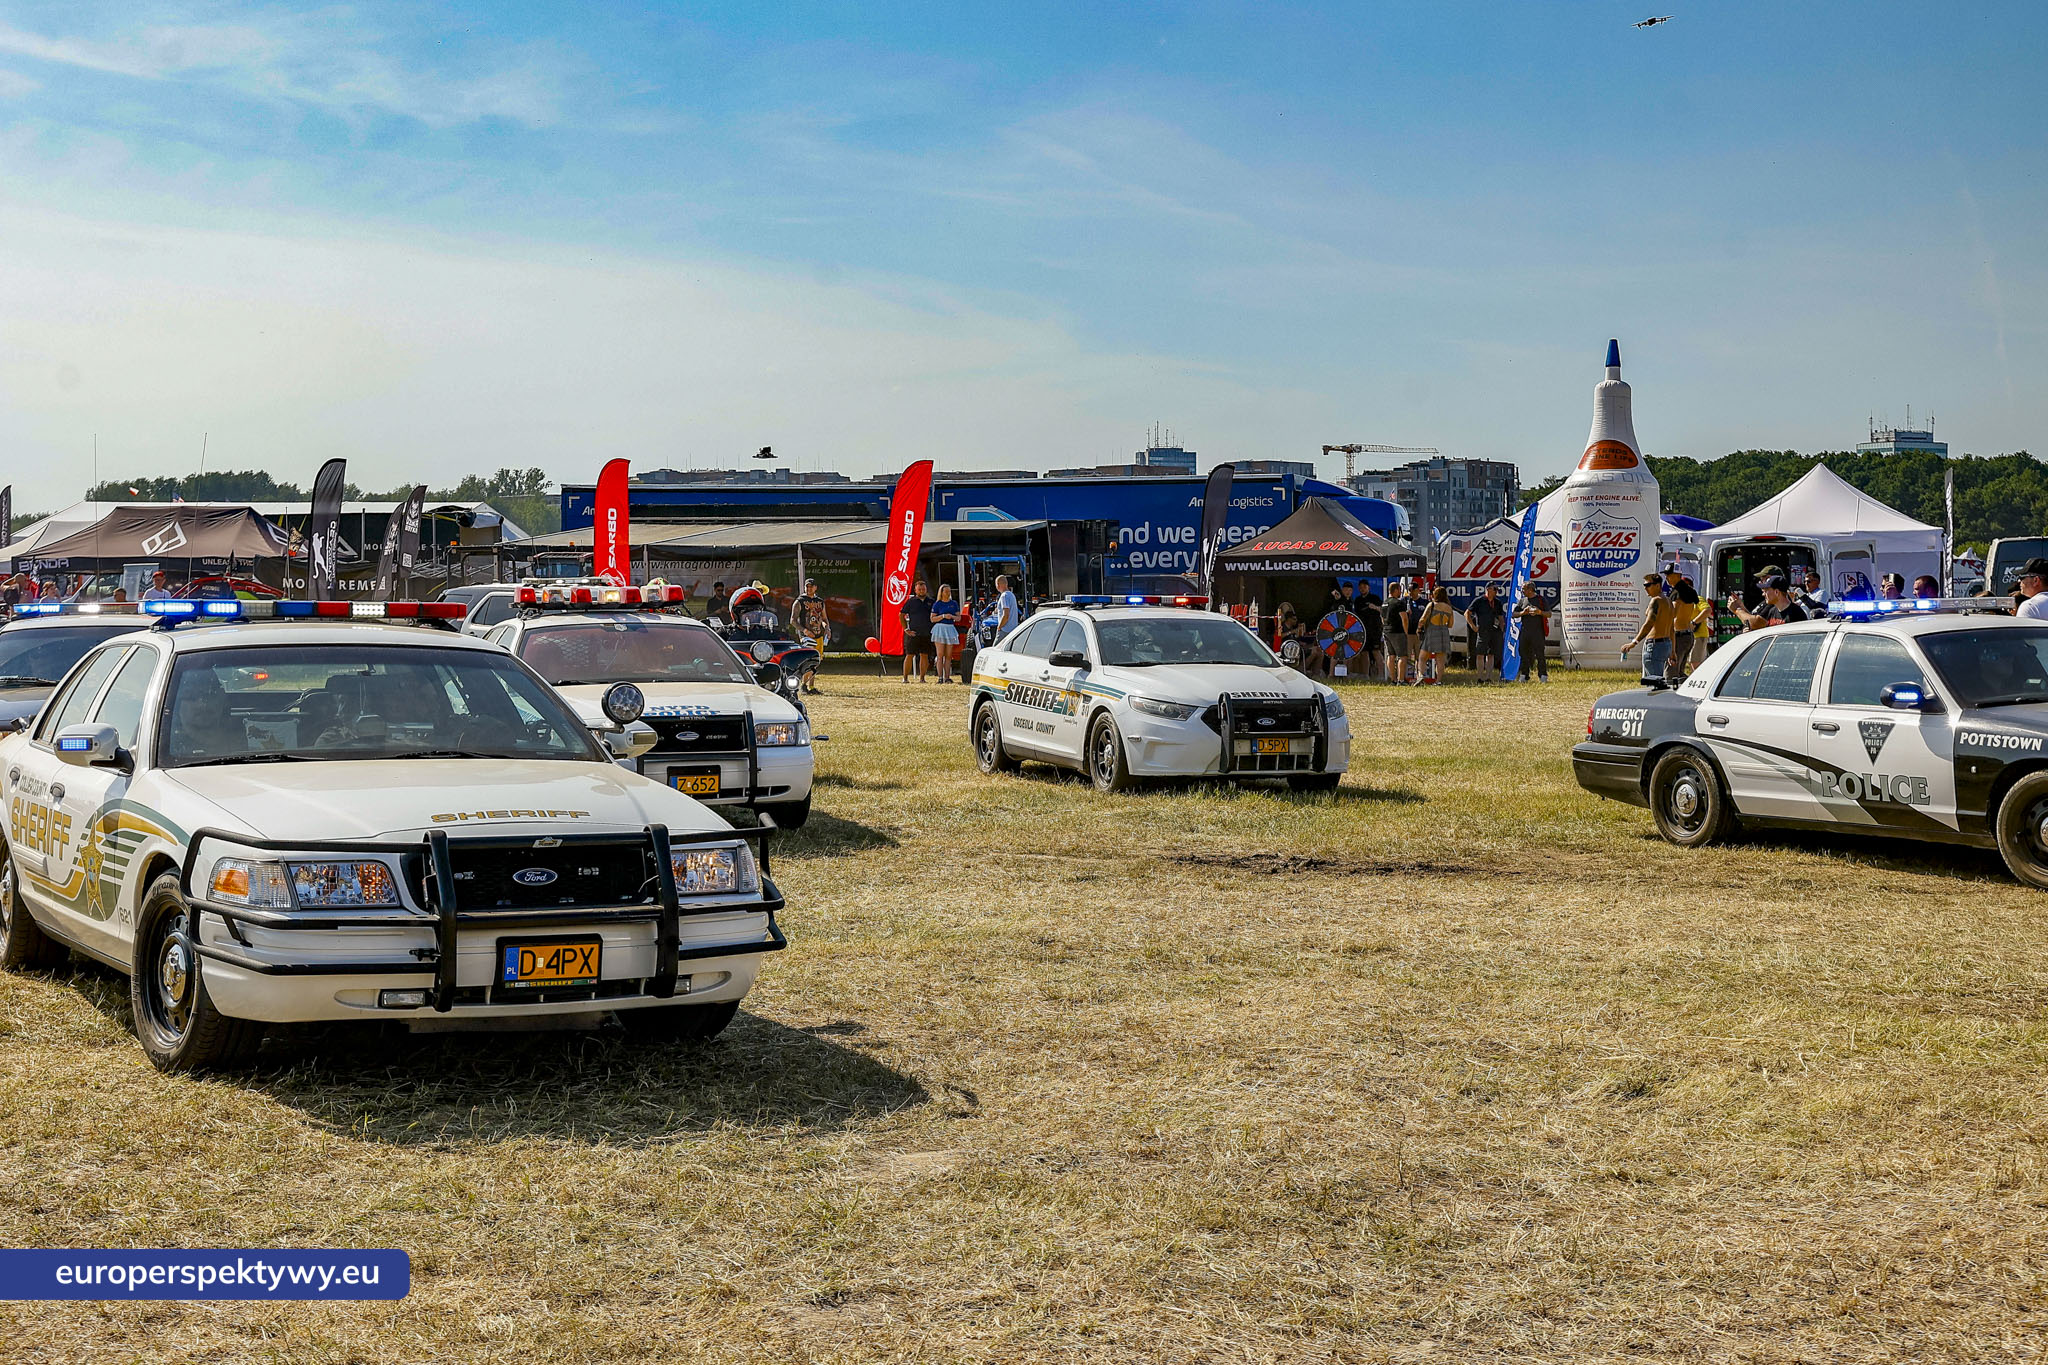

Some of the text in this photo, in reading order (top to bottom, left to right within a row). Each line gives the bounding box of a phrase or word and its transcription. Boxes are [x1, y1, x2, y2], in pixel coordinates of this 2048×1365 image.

[1228, 496, 1273, 509] Logistics
[607, 507, 617, 569] SARBO
[897, 509, 914, 573] SARBO
[1157, 525, 1195, 544] we
[1571, 531, 1637, 548] LUCAS
[1251, 541, 1349, 551] LUCAS OIL
[1569, 550, 1636, 561] HEAVY DUTY
[1224, 559, 1373, 573] www.LucasOil.co.uk
[1451, 555, 1556, 578] LUCS
[1574, 560, 1628, 569] Oil Stabilizer
[1446, 586, 1471, 597] OIL
[1687, 680, 1708, 689] 94-22
[1004, 682, 1061, 711] SHERIFF
[1230, 691, 1289, 699] SHERIFF
[1595, 708, 1648, 720] EMERGENCY
[1013, 716, 1034, 731] OSCEOLA
[1035, 721, 1057, 735] COUNTY
[1621, 720, 1644, 737] 911
[1258, 739, 1287, 751] D 5PX
[1864, 738, 1884, 746] POLICE
[1959, 731, 2043, 751] POTTSTOWN
[678, 777, 716, 792] Z 652
[1820, 770, 1931, 806] POLICE
[430, 809, 591, 823] SHERIFF
[11, 796, 73, 861] SHERIFF
[523, 871, 547, 882] Ford
[519, 946, 595, 977] D 4PX
[506, 966, 517, 975] PL
